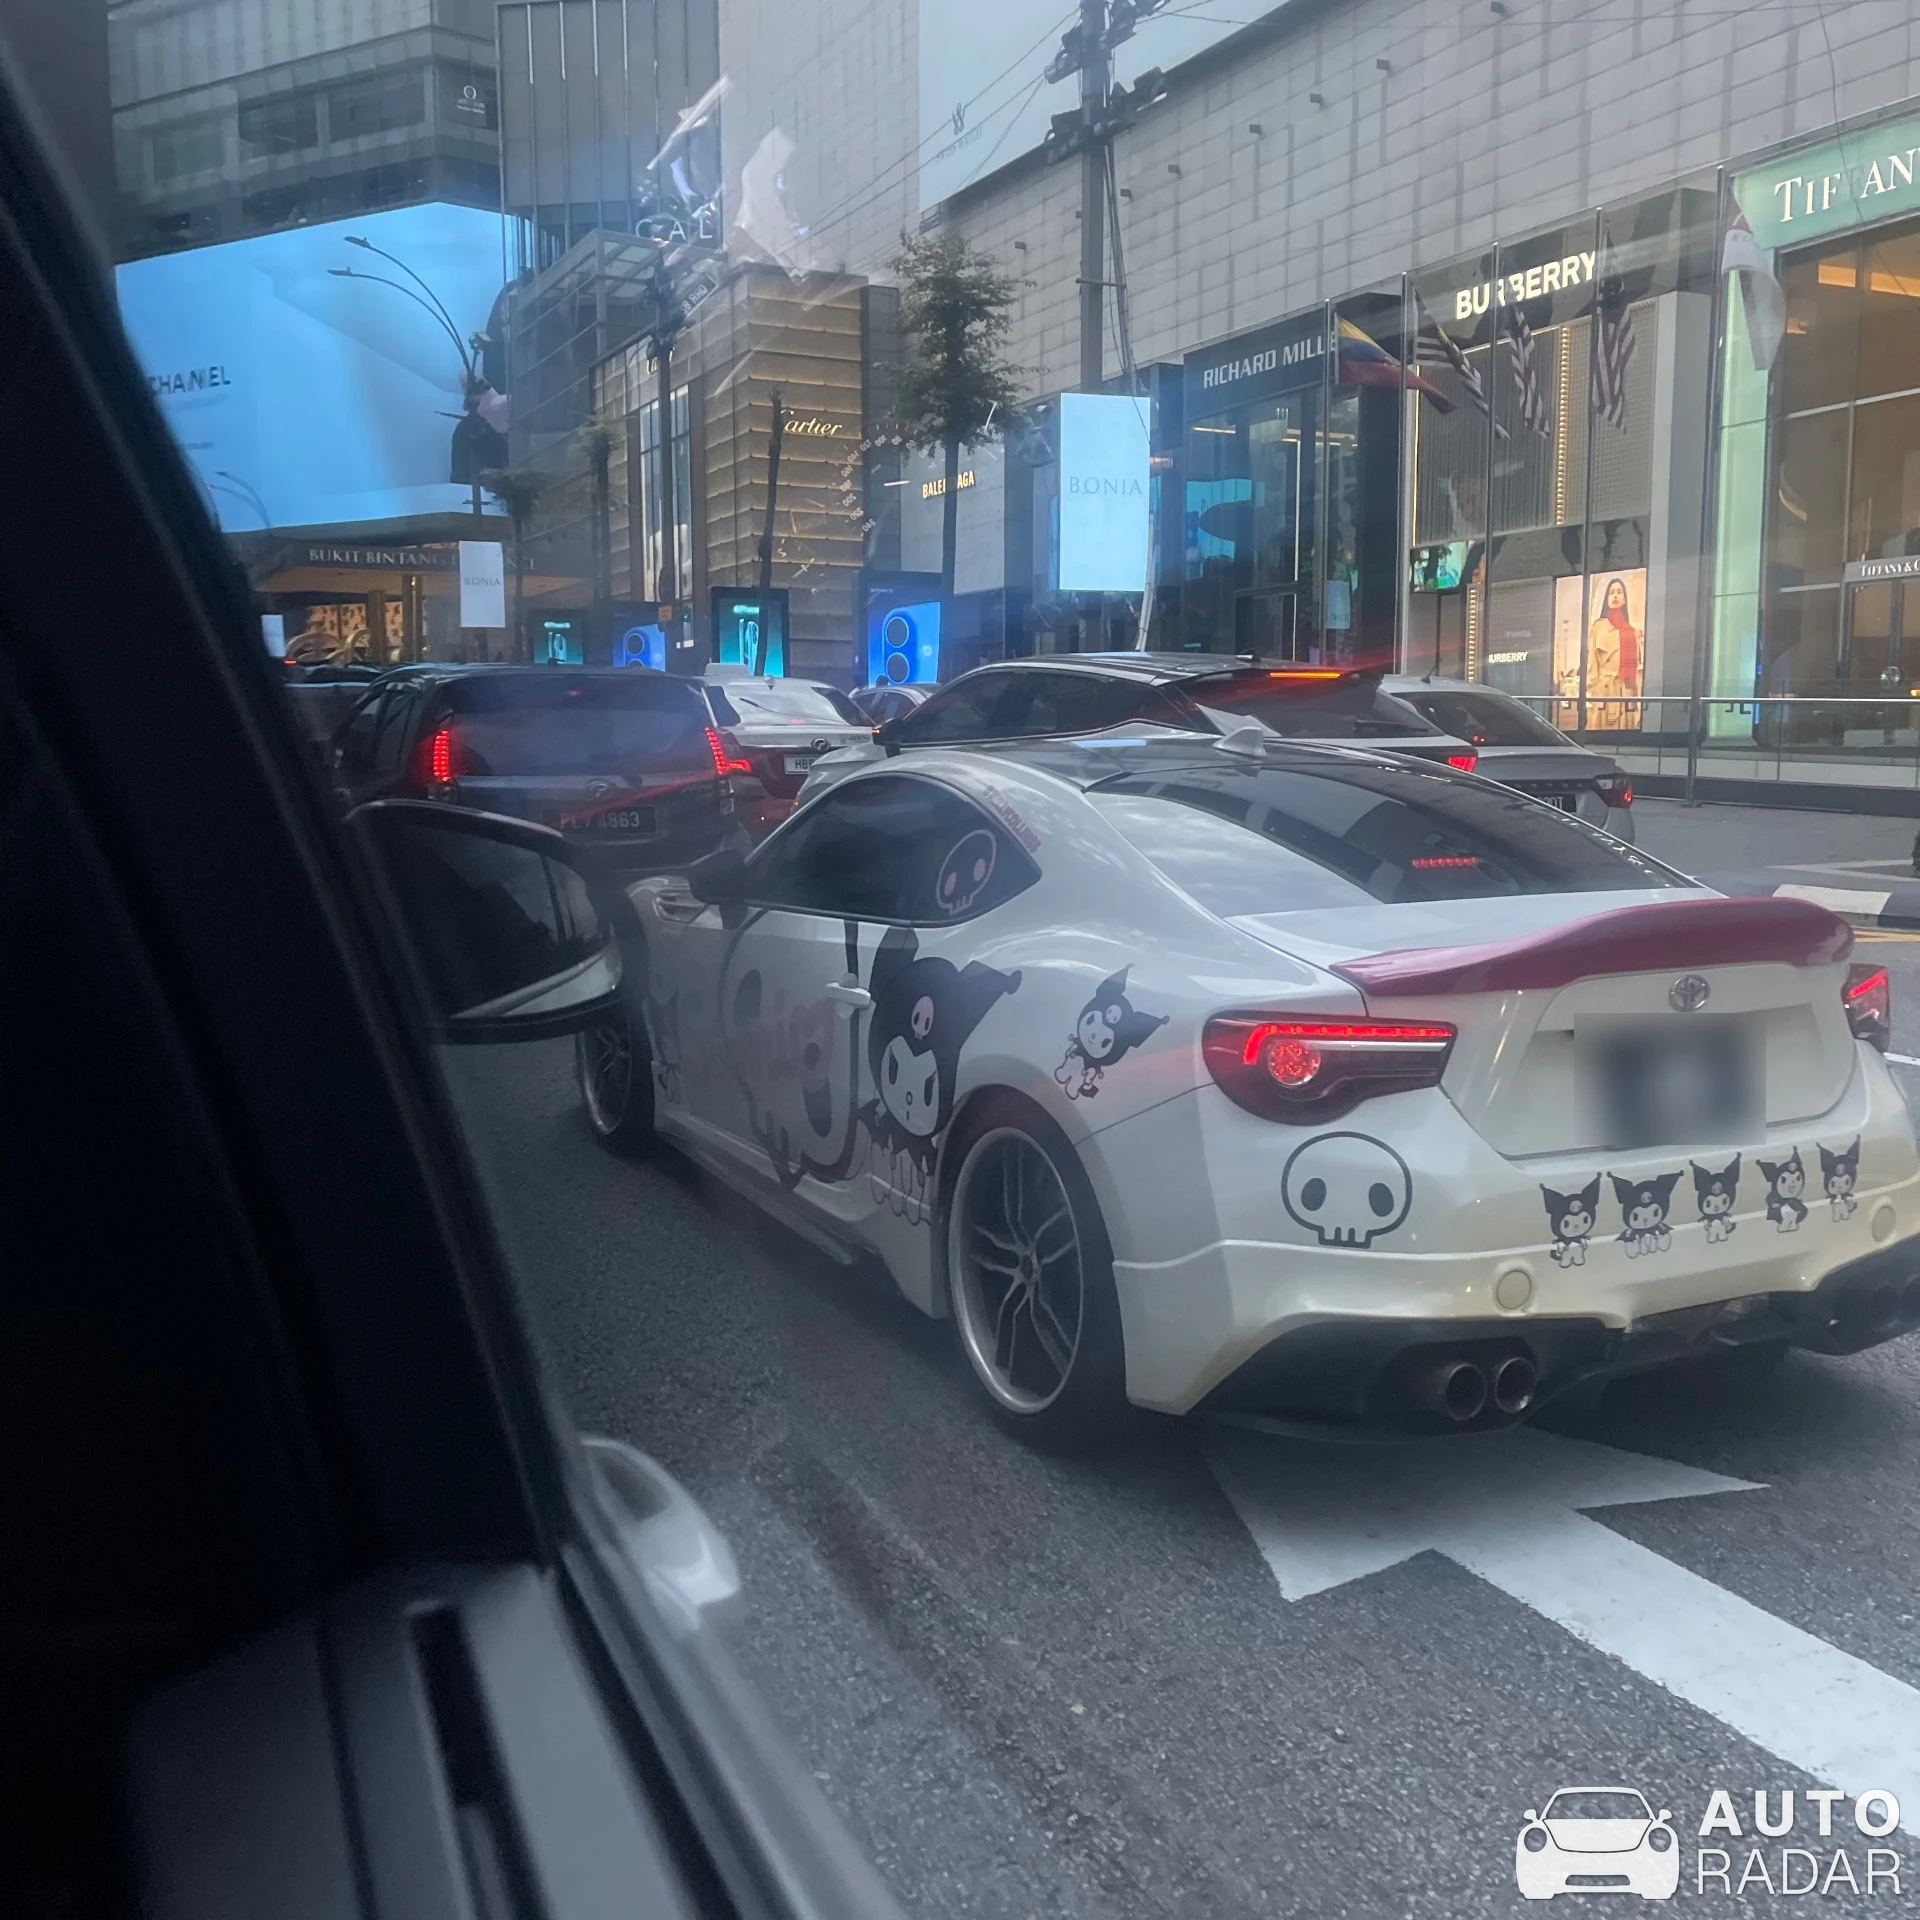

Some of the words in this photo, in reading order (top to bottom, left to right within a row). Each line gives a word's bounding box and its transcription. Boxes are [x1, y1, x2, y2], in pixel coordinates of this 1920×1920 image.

[1773, 148, 1920, 223] TIFAN
[1203, 349, 1277, 389] RICHARD
[922, 470, 975, 499] BALEAGA
[1069, 476, 1143, 496] BONIA
[309, 548, 358, 564] BUKIT
[464, 576, 501, 586] BONIA
